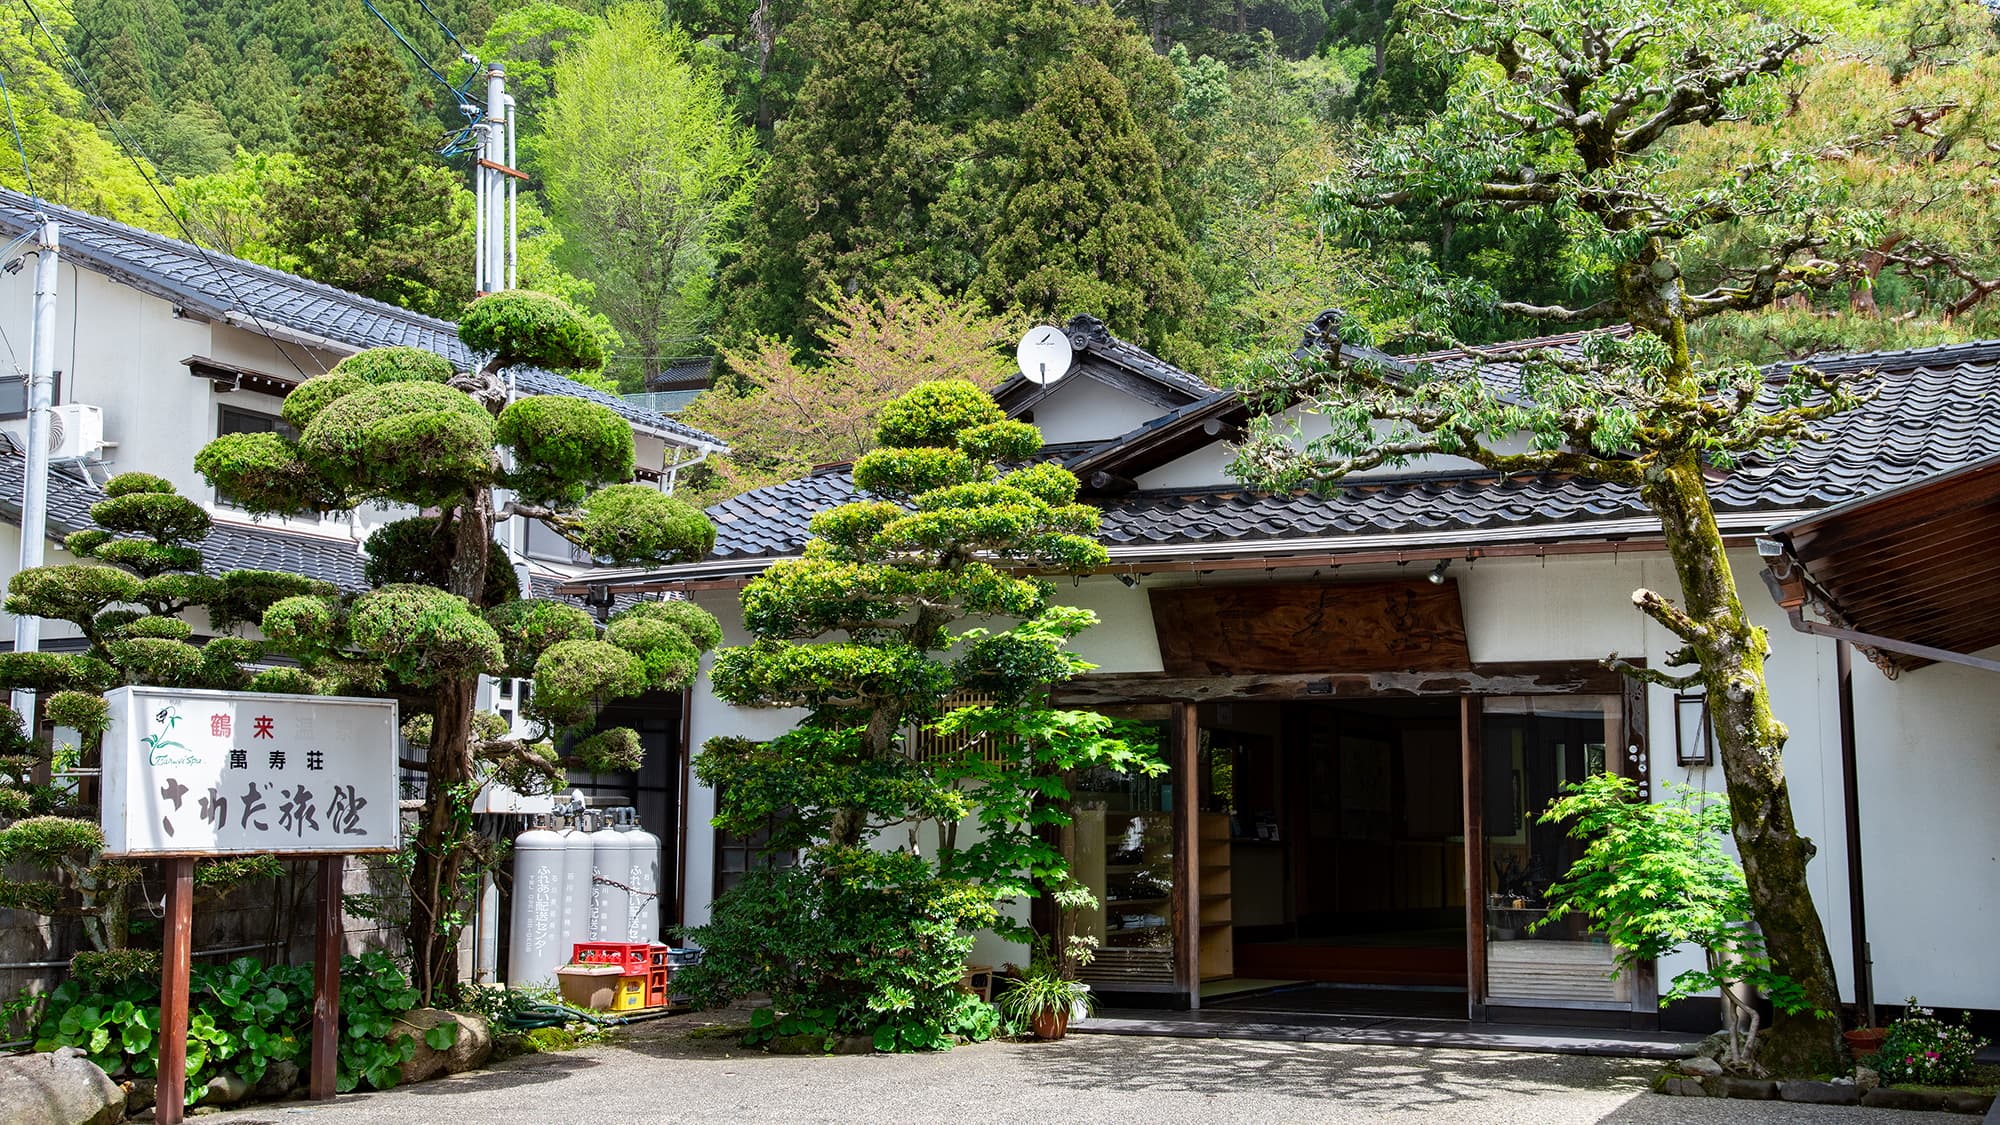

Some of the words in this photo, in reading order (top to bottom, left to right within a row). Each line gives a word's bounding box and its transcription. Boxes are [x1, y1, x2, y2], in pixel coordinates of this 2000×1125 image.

[210, 713, 274, 739] 鶴来
[230, 749, 324, 770] 萬寿荘
